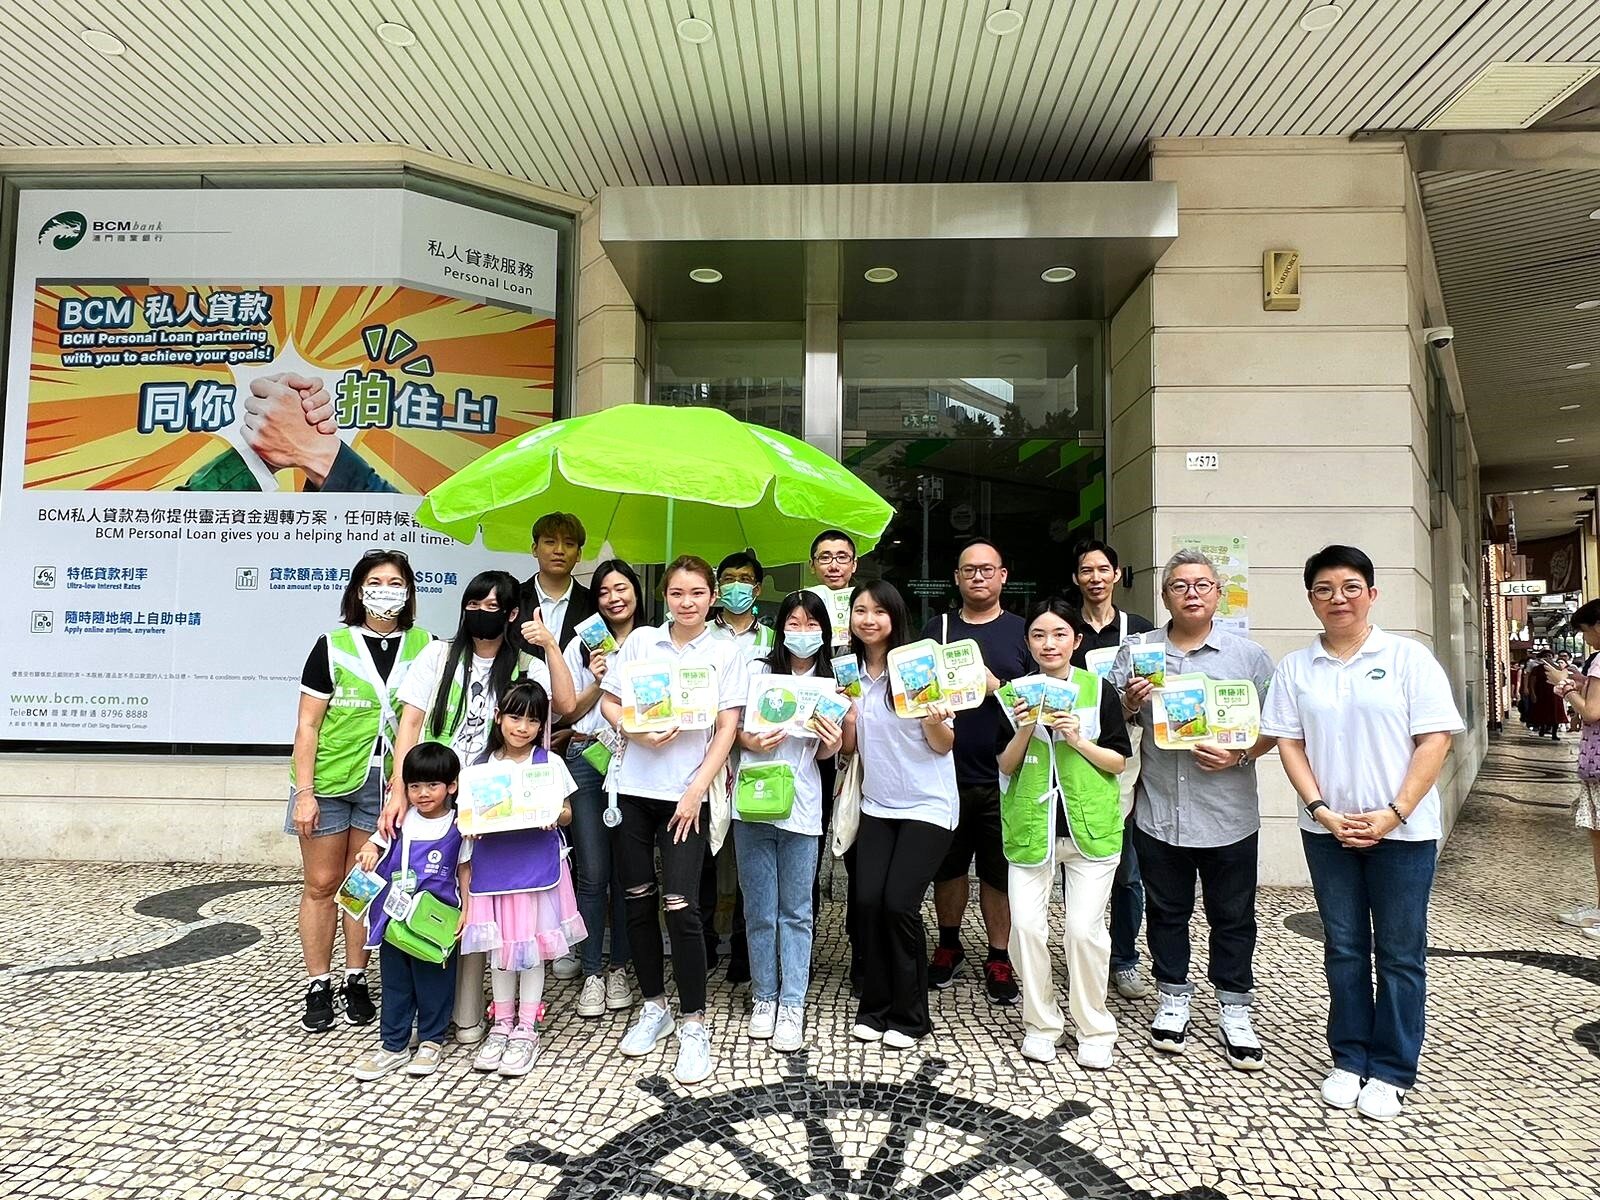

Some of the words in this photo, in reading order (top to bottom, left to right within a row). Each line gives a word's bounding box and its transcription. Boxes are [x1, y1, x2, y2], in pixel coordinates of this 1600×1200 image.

[427, 239, 534, 279] 私人貸款服務
[444, 266, 499, 289] Personal
[503, 280, 533, 296] Loan
[63, 300, 131, 325] BCM
[145, 293, 269, 324] 私人貸款
[63, 333, 95, 345] BCM
[99, 332, 156, 344] Personal
[160, 331, 194, 343] Loan
[196, 330, 267, 344] partnering
[63, 353, 93, 364] with
[96, 355, 121, 366] you
[124, 352, 137, 362] to
[140, 350, 192, 361] achieve
[195, 352, 226, 364] your
[229, 346, 271, 362] goals!
[144, 384, 236, 429] 同你
[337, 372, 491, 431] 拍住上!
[95, 528, 124, 539] BCM
[129, 527, 182, 539] Personal
[187, 528, 216, 540] Loan
[221, 529, 252, 543] gives
[257, 531, 280, 543] you
[283, 532, 291, 540] a
[295, 529, 342, 543] helping
[347, 529, 380, 541] hand
[383, 531, 395, 541] at
[400, 531, 416, 542] all
[420, 533, 454, 545] time!
[67, 567, 148, 580] 特低貸款利率
[270, 568, 351, 581] 貸款額高達月
[64, 611, 201, 626] 隨時隨地網上自助申請
[64, 626, 83, 634] Apply
[10, 692, 149, 706] www.bcm.com.mo
[10, 708, 48, 717] TeleBCM
[100, 709, 123, 719] 8796
[125, 710, 148, 719] 8888
